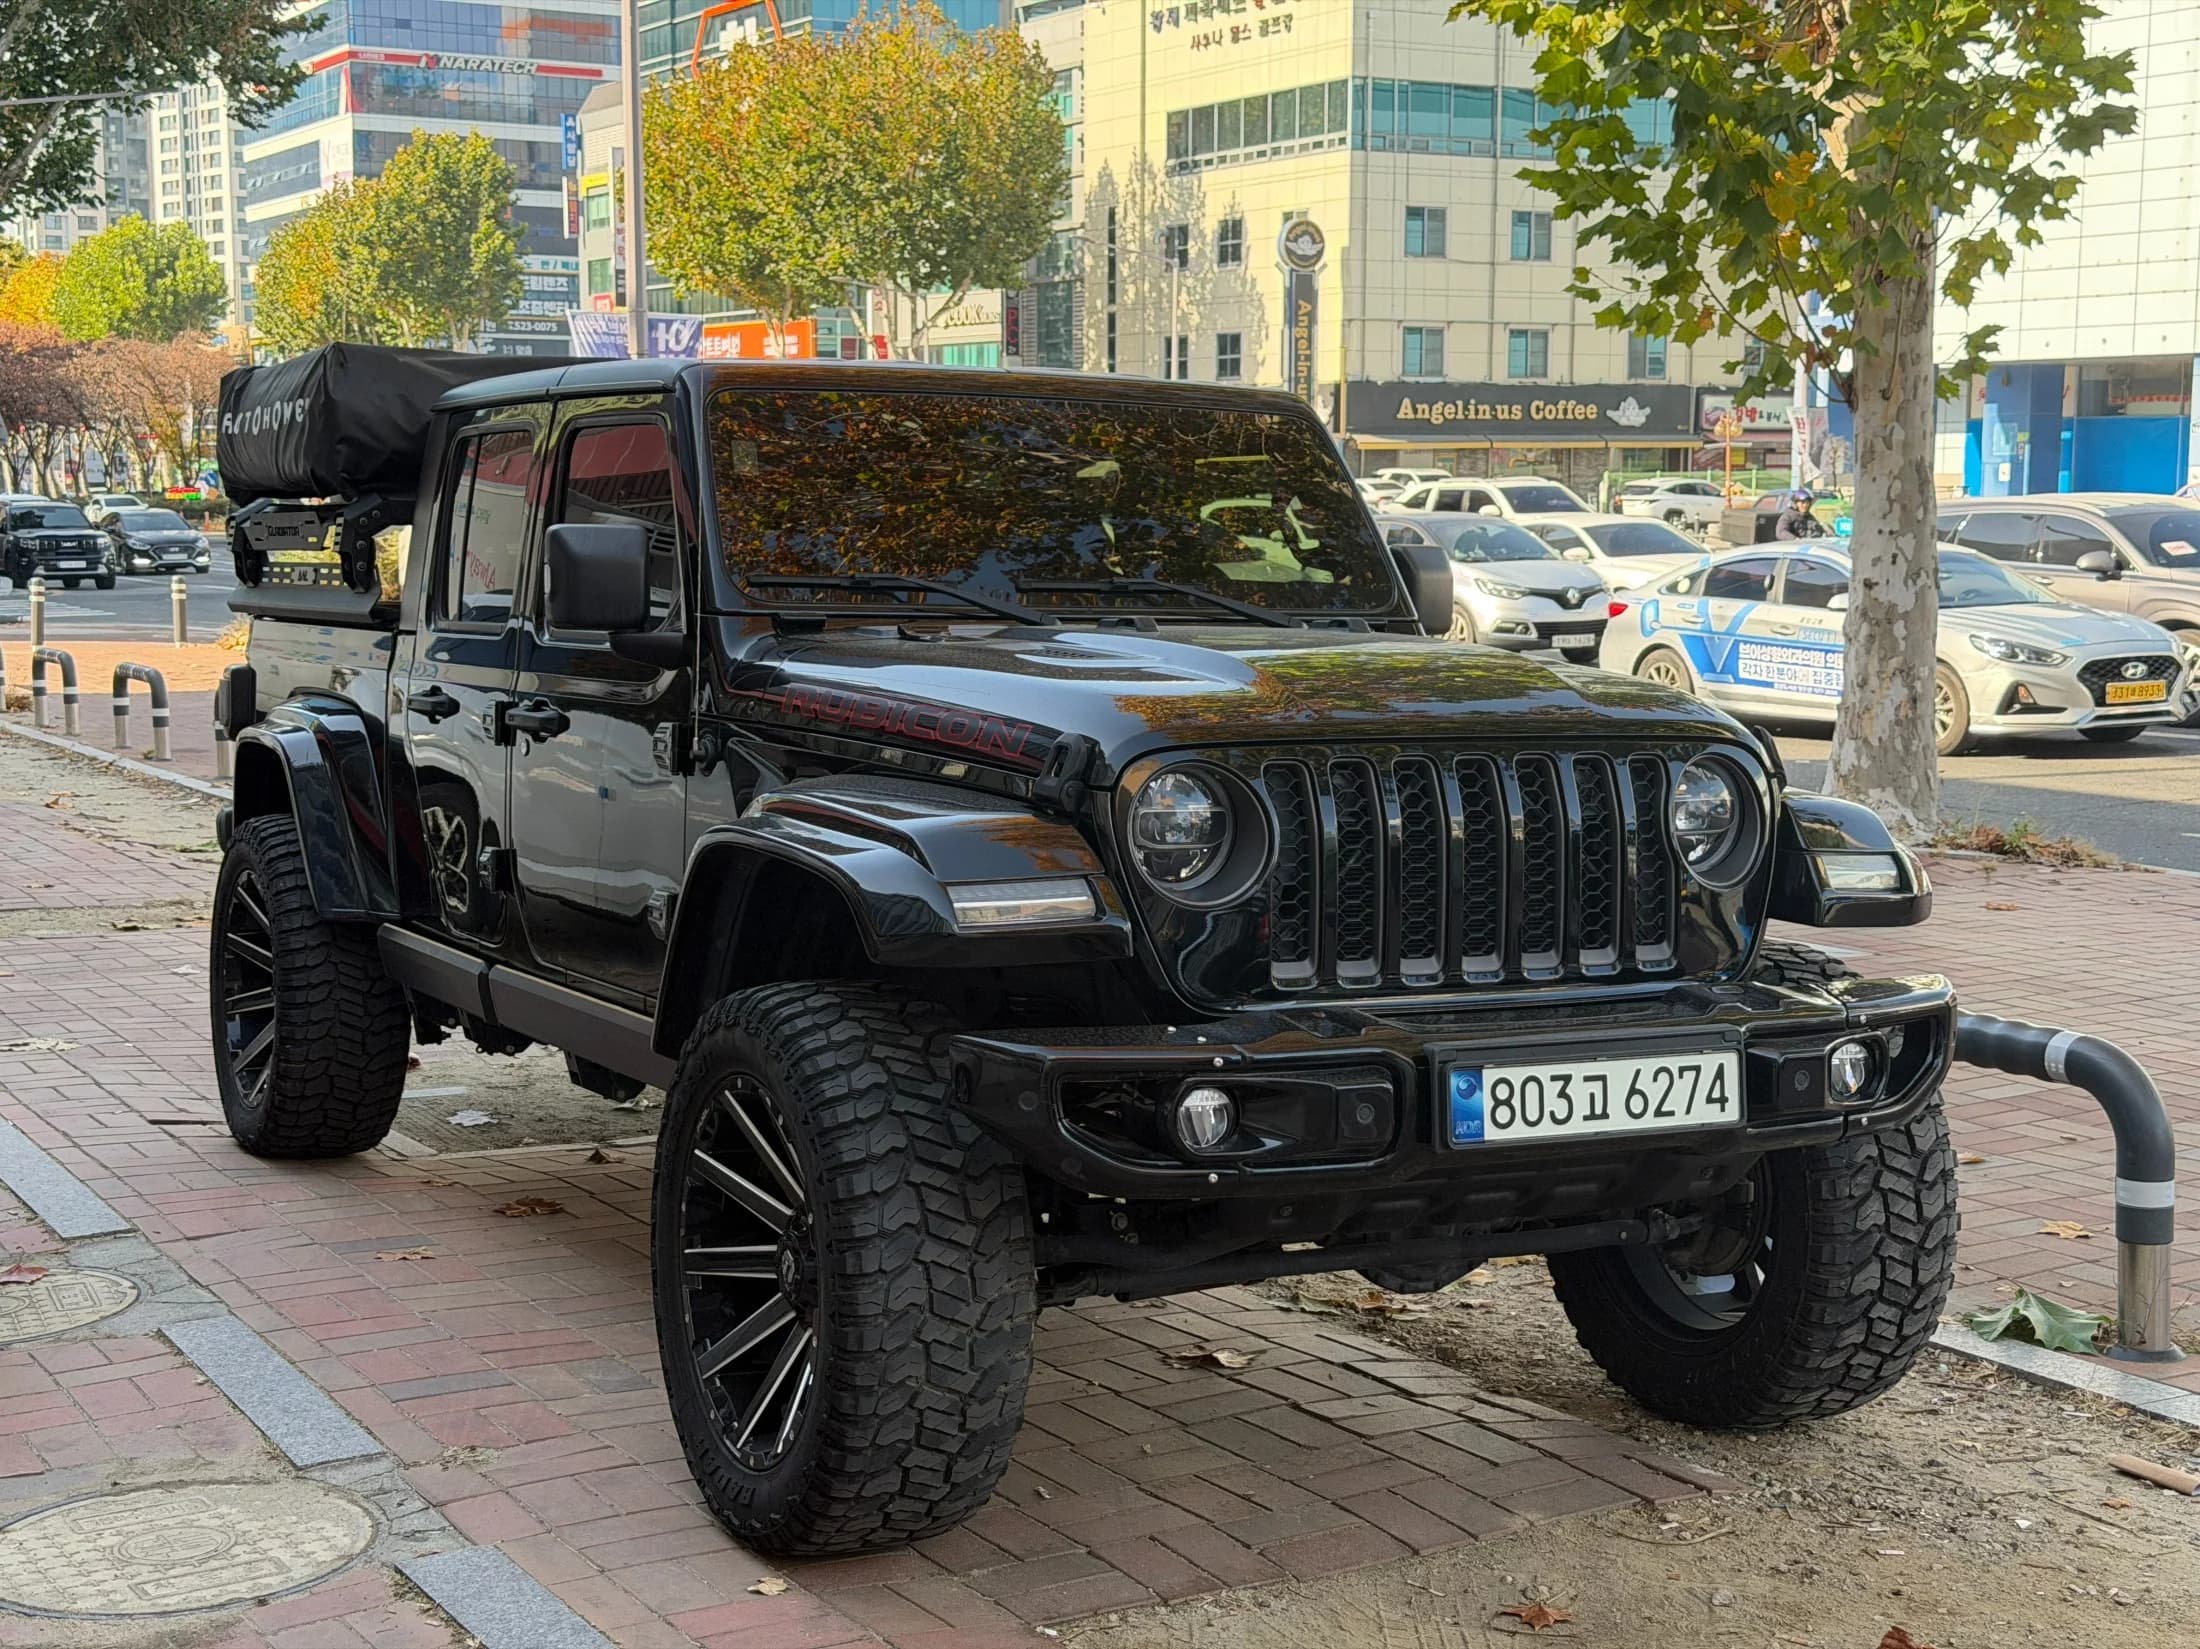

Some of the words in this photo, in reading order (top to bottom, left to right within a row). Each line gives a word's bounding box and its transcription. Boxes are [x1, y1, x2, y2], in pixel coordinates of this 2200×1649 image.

[438, 56, 538, 75] NARATECH
[1530, 400, 1598, 421] Coffee
[781, 684, 1034, 758] RUBICON
[1490, 1073, 1610, 1130] 803고
[1624, 1062, 1729, 1120] 6274
